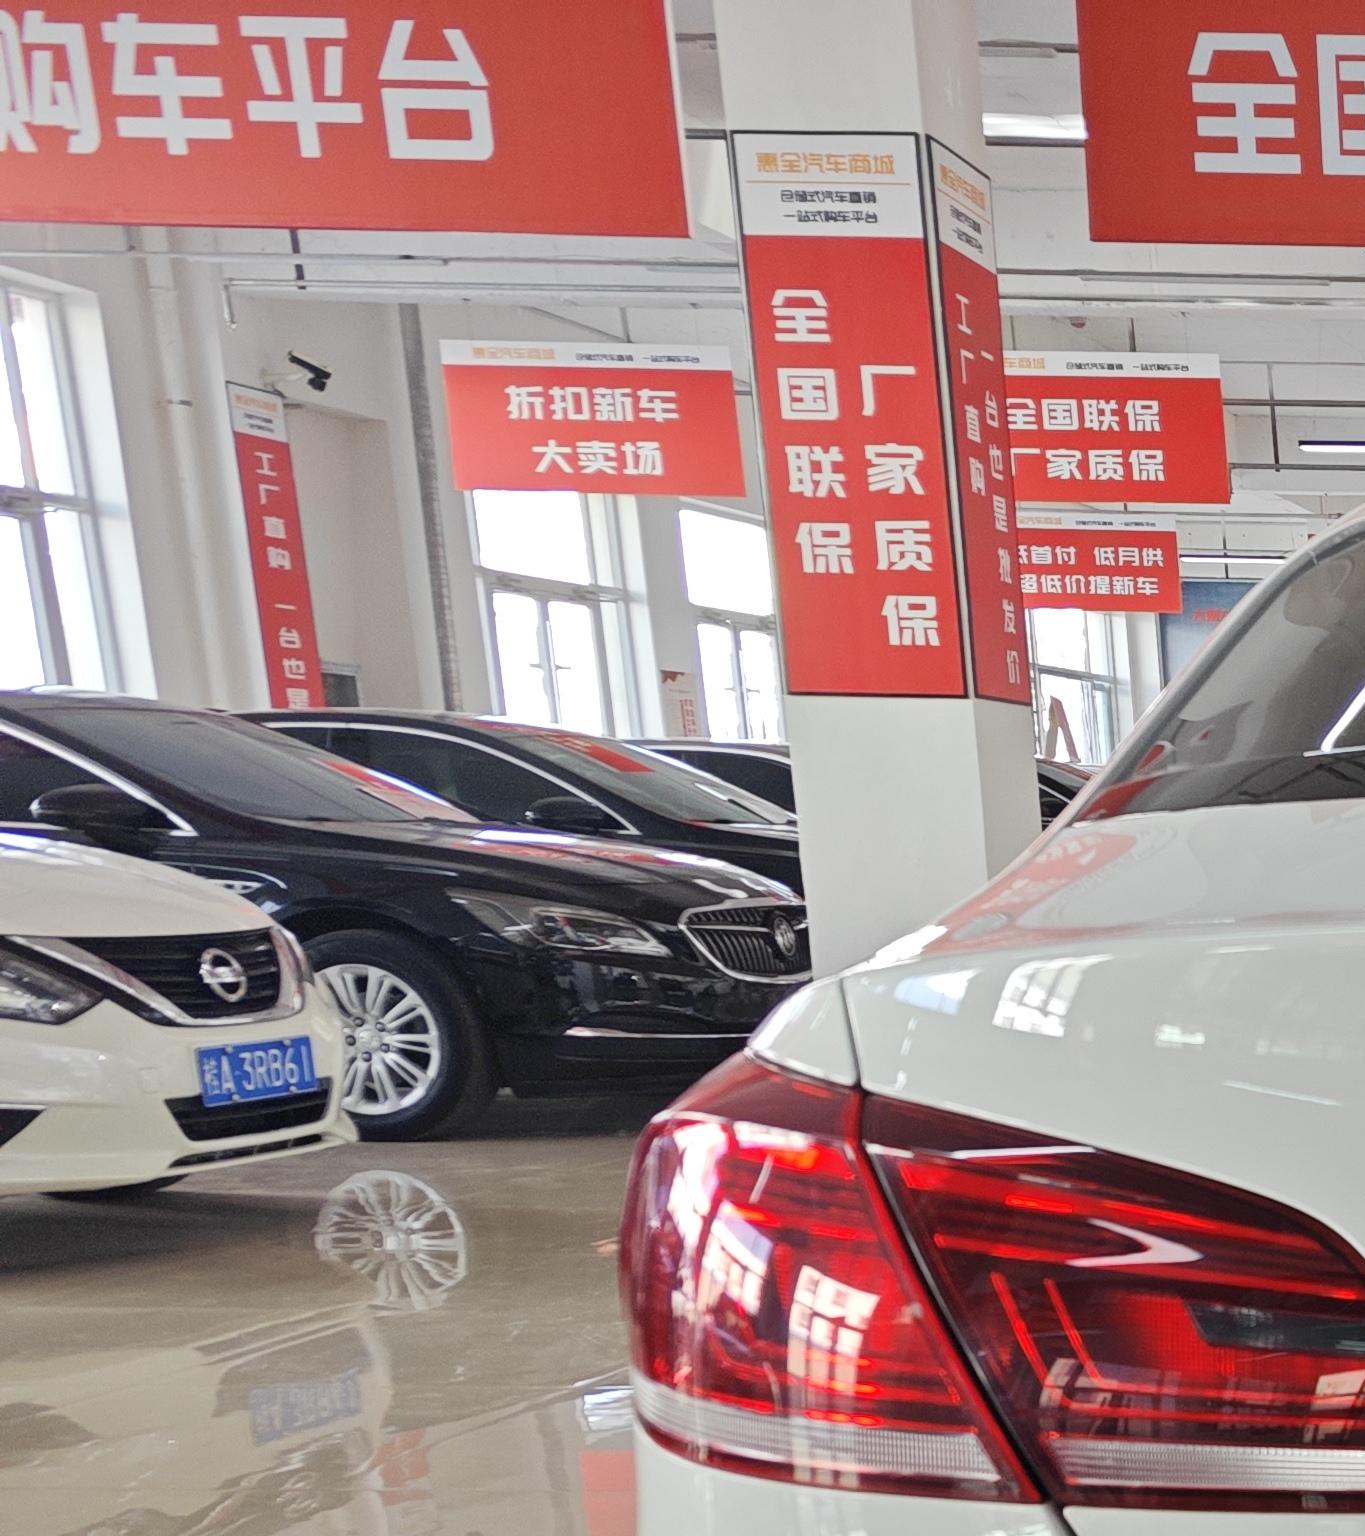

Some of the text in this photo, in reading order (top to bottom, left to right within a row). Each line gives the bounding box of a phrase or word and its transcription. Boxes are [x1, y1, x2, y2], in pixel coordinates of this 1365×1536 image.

[0, 10, 495, 161] 购车平台
[756, 151, 896, 175] 惠全汽车商城
[504, 385, 681, 423] 折扣新车
[1006, 397, 1162, 433] 全国联保
[770, 288, 855, 576] 全国联保
[531, 439, 664, 476] 大卖场
[1010, 447, 1167, 482] 厂家质保
[859, 364, 942, 648] 厂家质保
[1093, 546, 1165, 568] 低月供
[1020, 573, 1160, 596] 超低价提新车
